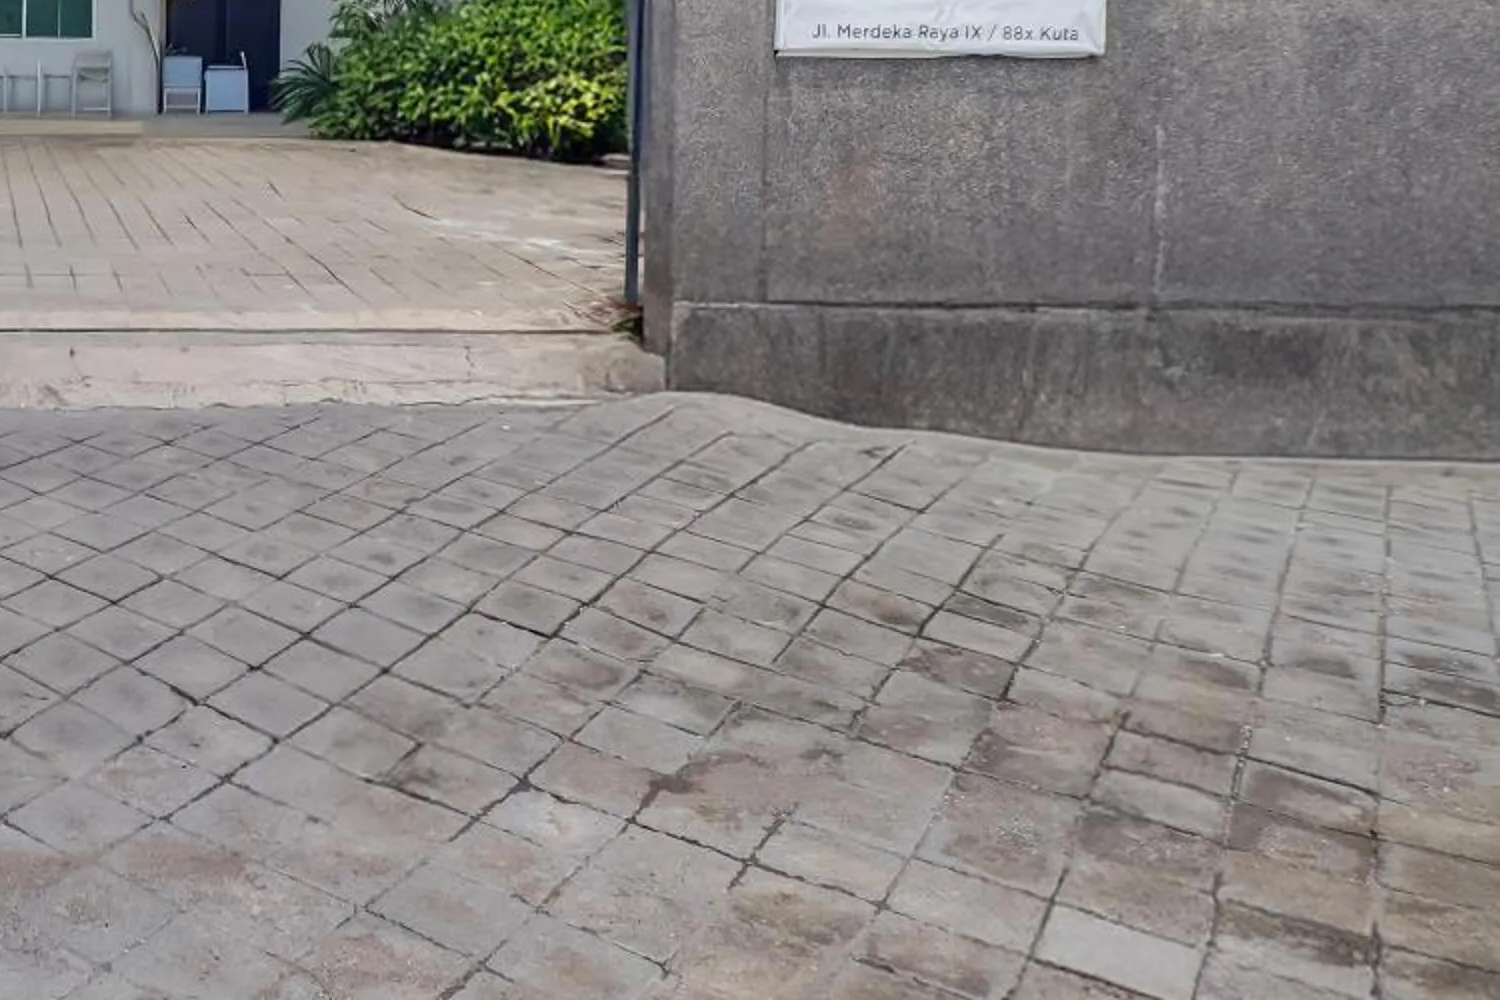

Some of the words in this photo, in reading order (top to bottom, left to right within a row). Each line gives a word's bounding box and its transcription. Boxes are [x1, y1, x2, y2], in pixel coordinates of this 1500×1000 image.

[837, 23, 912, 39] Merdeka
[918, 24, 959, 42] Raya
[965, 25, 982, 39] IX
[1003, 25, 1033, 41] 88x
[1040, 26, 1079, 41] Kuta
